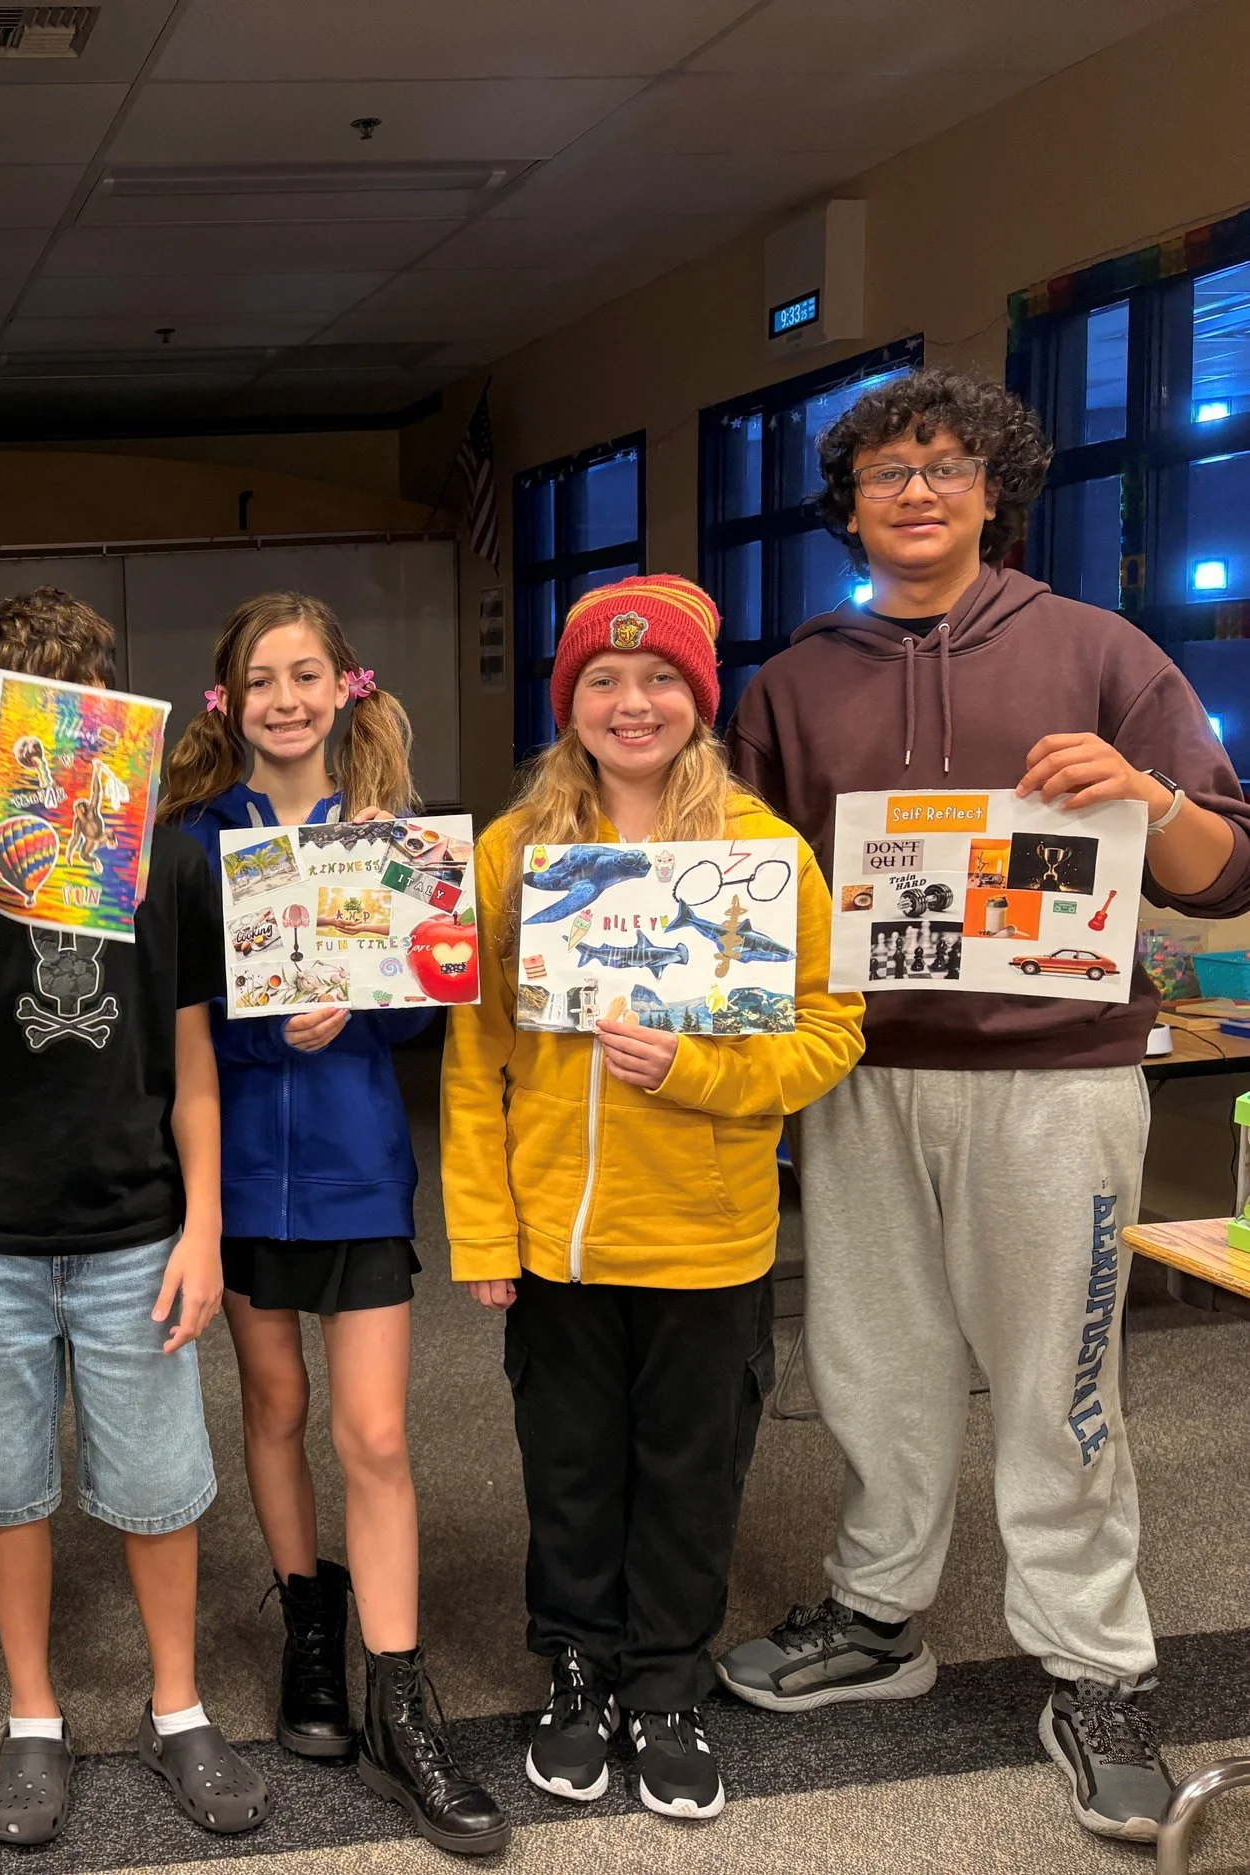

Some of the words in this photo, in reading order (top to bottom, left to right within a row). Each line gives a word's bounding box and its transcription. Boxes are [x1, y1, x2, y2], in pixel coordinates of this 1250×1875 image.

[781, 304, 800, 328] 9:33
[893, 807, 922, 822] Self
[927, 806, 983, 821] Reflect
[866, 841, 921, 854] DON'T
[309, 859, 380, 876] KINDNESS
[398, 873, 445, 900] ITALY
[889, 873, 916, 885] Train
[895, 878, 927, 891] HARD
[336, 909, 370, 921] AND
[603, 914, 657, 932] RILEY
[236, 924, 272, 942] Cooking
[316, 940, 348, 951] FUN
[357, 936, 412, 950] TIMES
